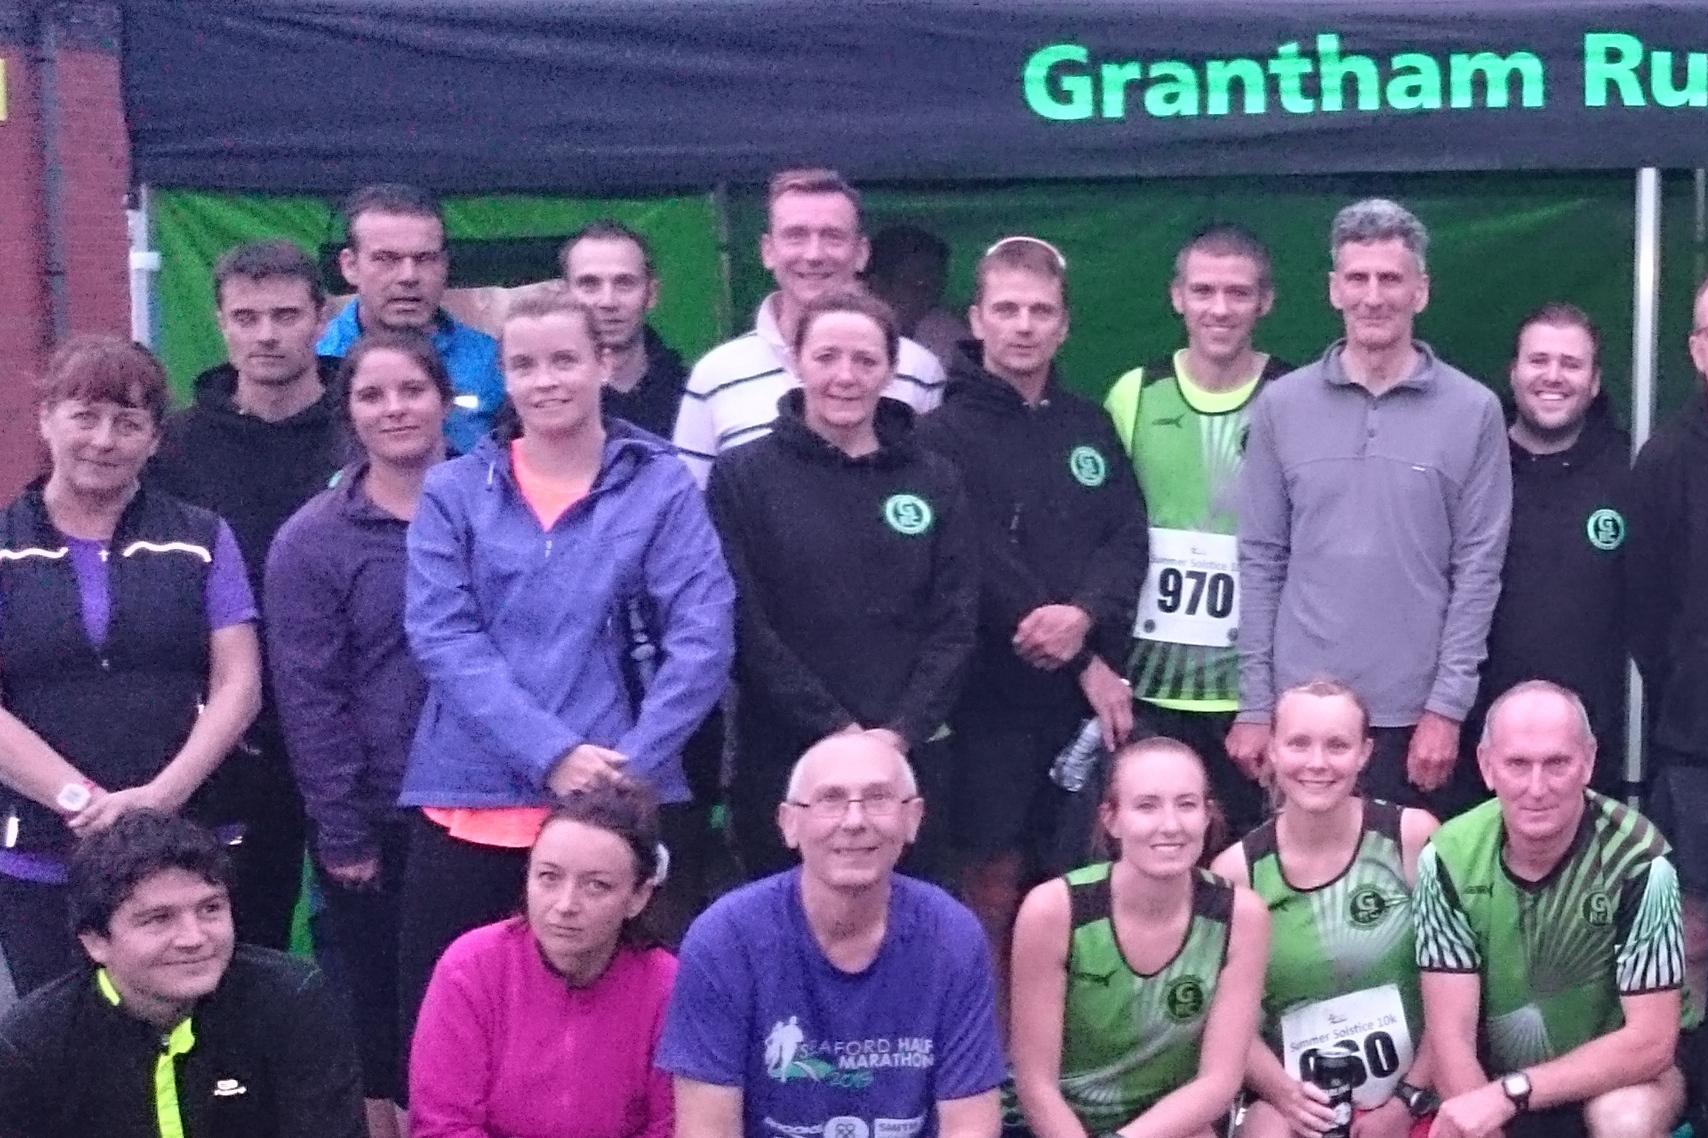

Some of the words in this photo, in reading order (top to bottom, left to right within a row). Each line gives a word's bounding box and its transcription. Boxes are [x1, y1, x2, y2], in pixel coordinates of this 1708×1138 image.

[1023, 34, 1544, 121] Grantham
[1157, 567, 1235, 619] 970
[799, 1038, 890, 1058] SEAFORD
[898, 1037, 933, 1054] HALF
[1290, 1032, 1329, 1052] Summer
[1333, 1021, 1374, 1039] Solstice
[1378, 1014, 1397, 1027] 10k
[839, 1053, 935, 1069] MARATHON
